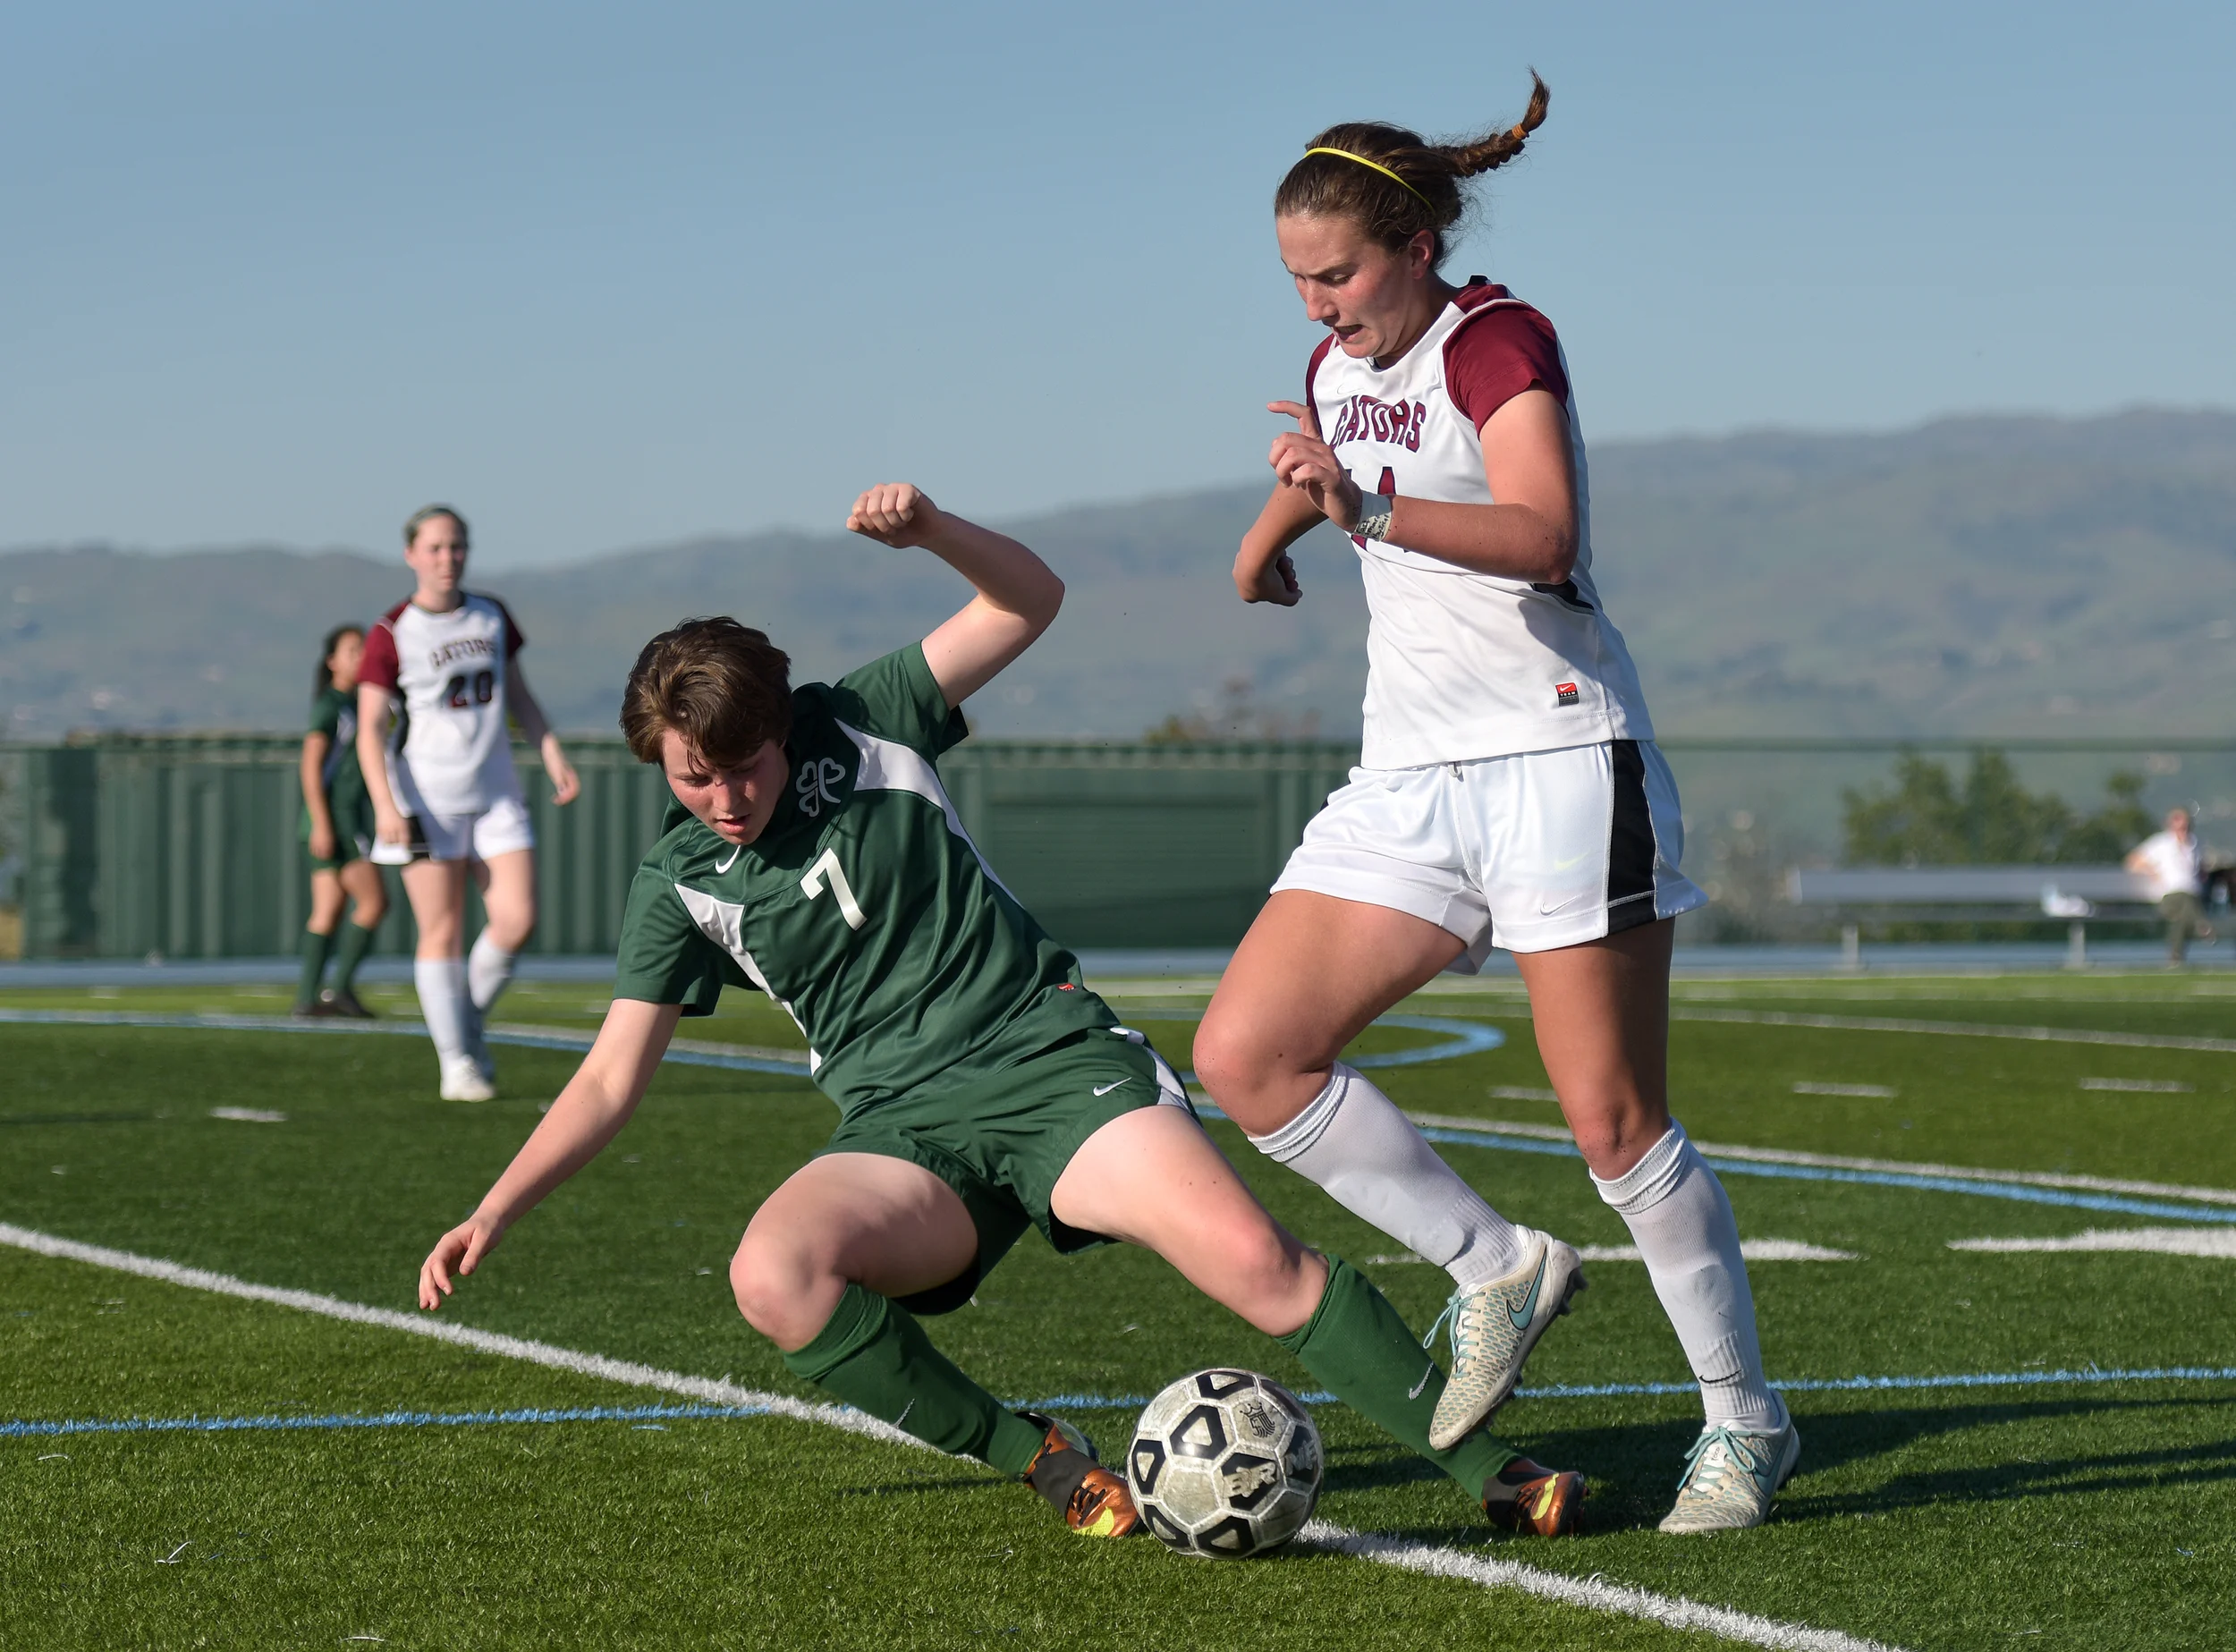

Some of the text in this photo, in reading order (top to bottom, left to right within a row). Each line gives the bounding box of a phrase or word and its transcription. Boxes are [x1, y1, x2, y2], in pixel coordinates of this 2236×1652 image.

[1330, 394, 1426, 453] GATORS
[449, 671, 494, 708] 20
[800, 848, 868, 931] 7
